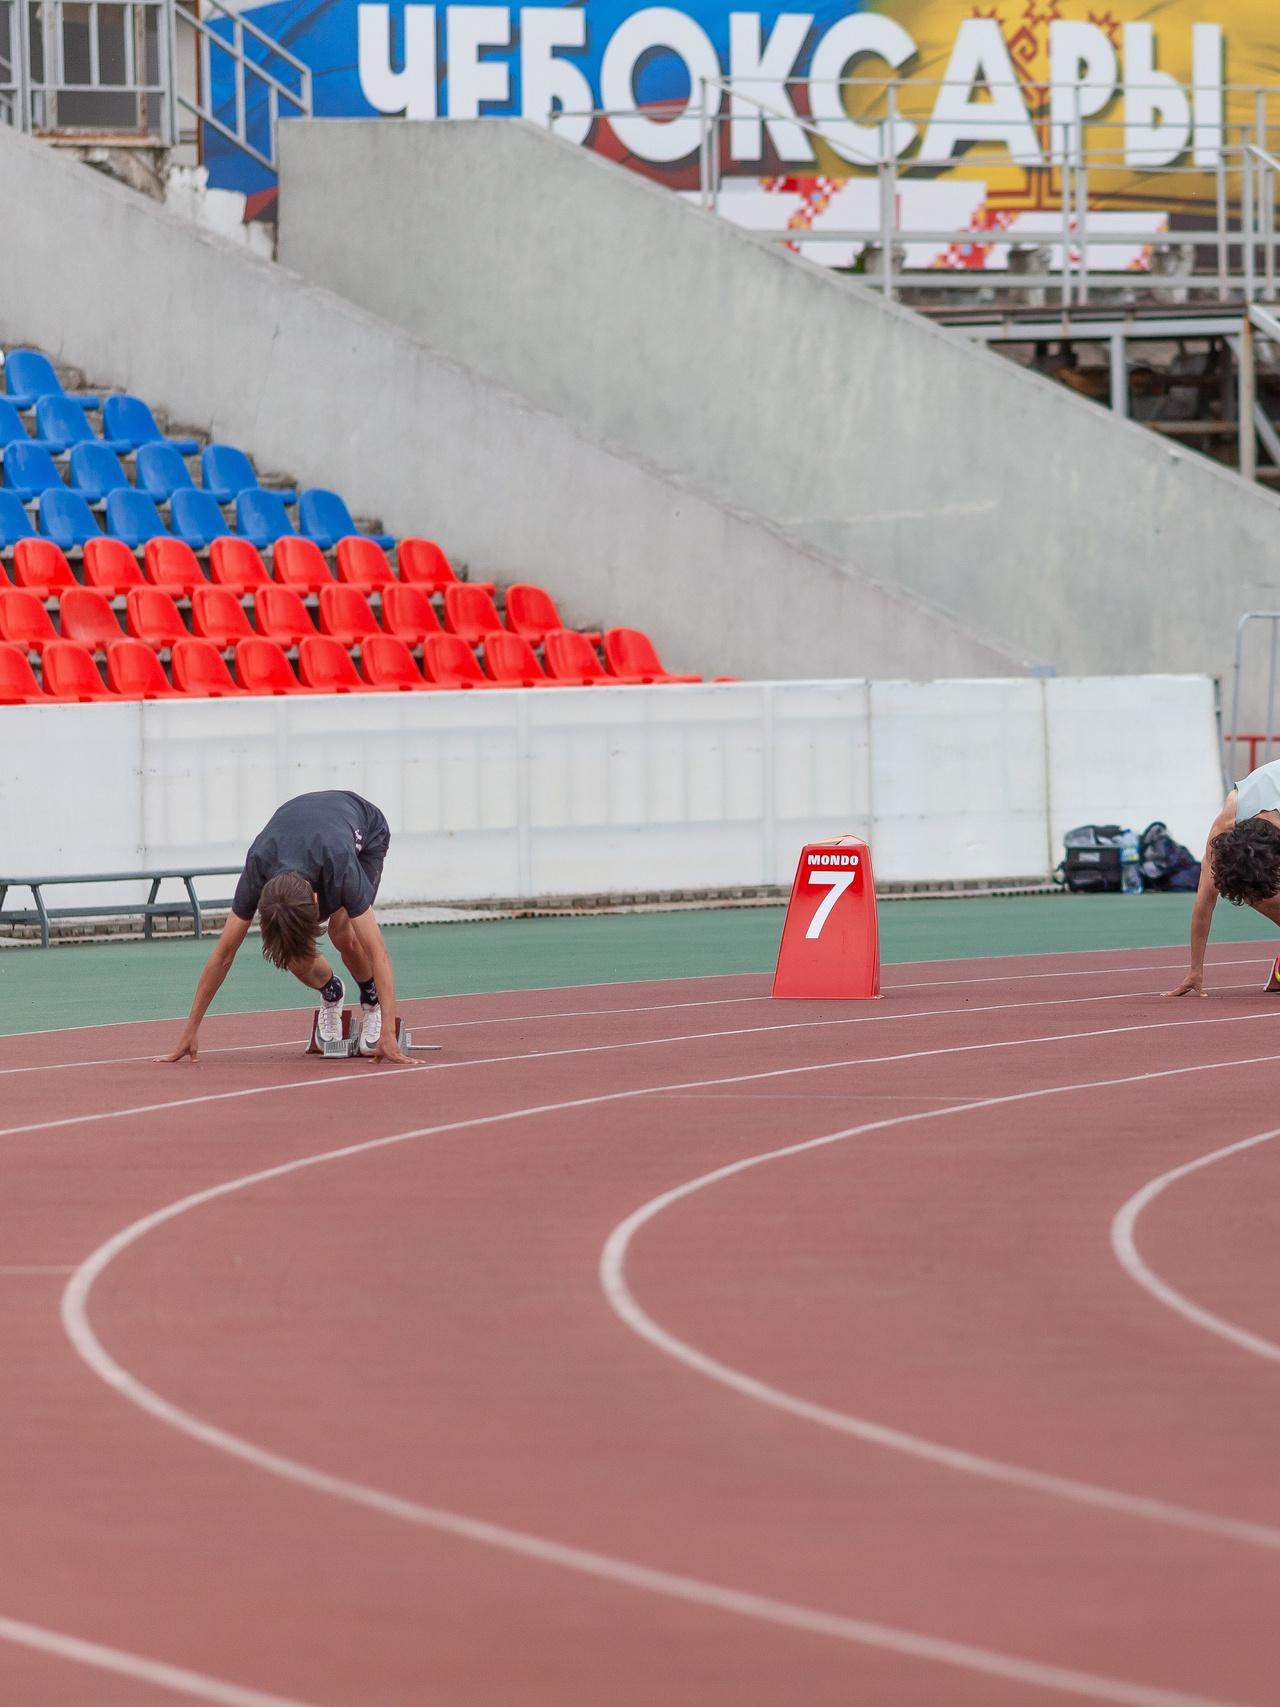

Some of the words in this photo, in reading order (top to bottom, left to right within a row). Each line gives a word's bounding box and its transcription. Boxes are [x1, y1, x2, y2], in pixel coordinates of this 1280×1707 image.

[358, 4, 1222, 168] ЧЕБОКСАРЫ
[808, 855, 858, 865] MONDO
[805, 871, 856, 939] 7
